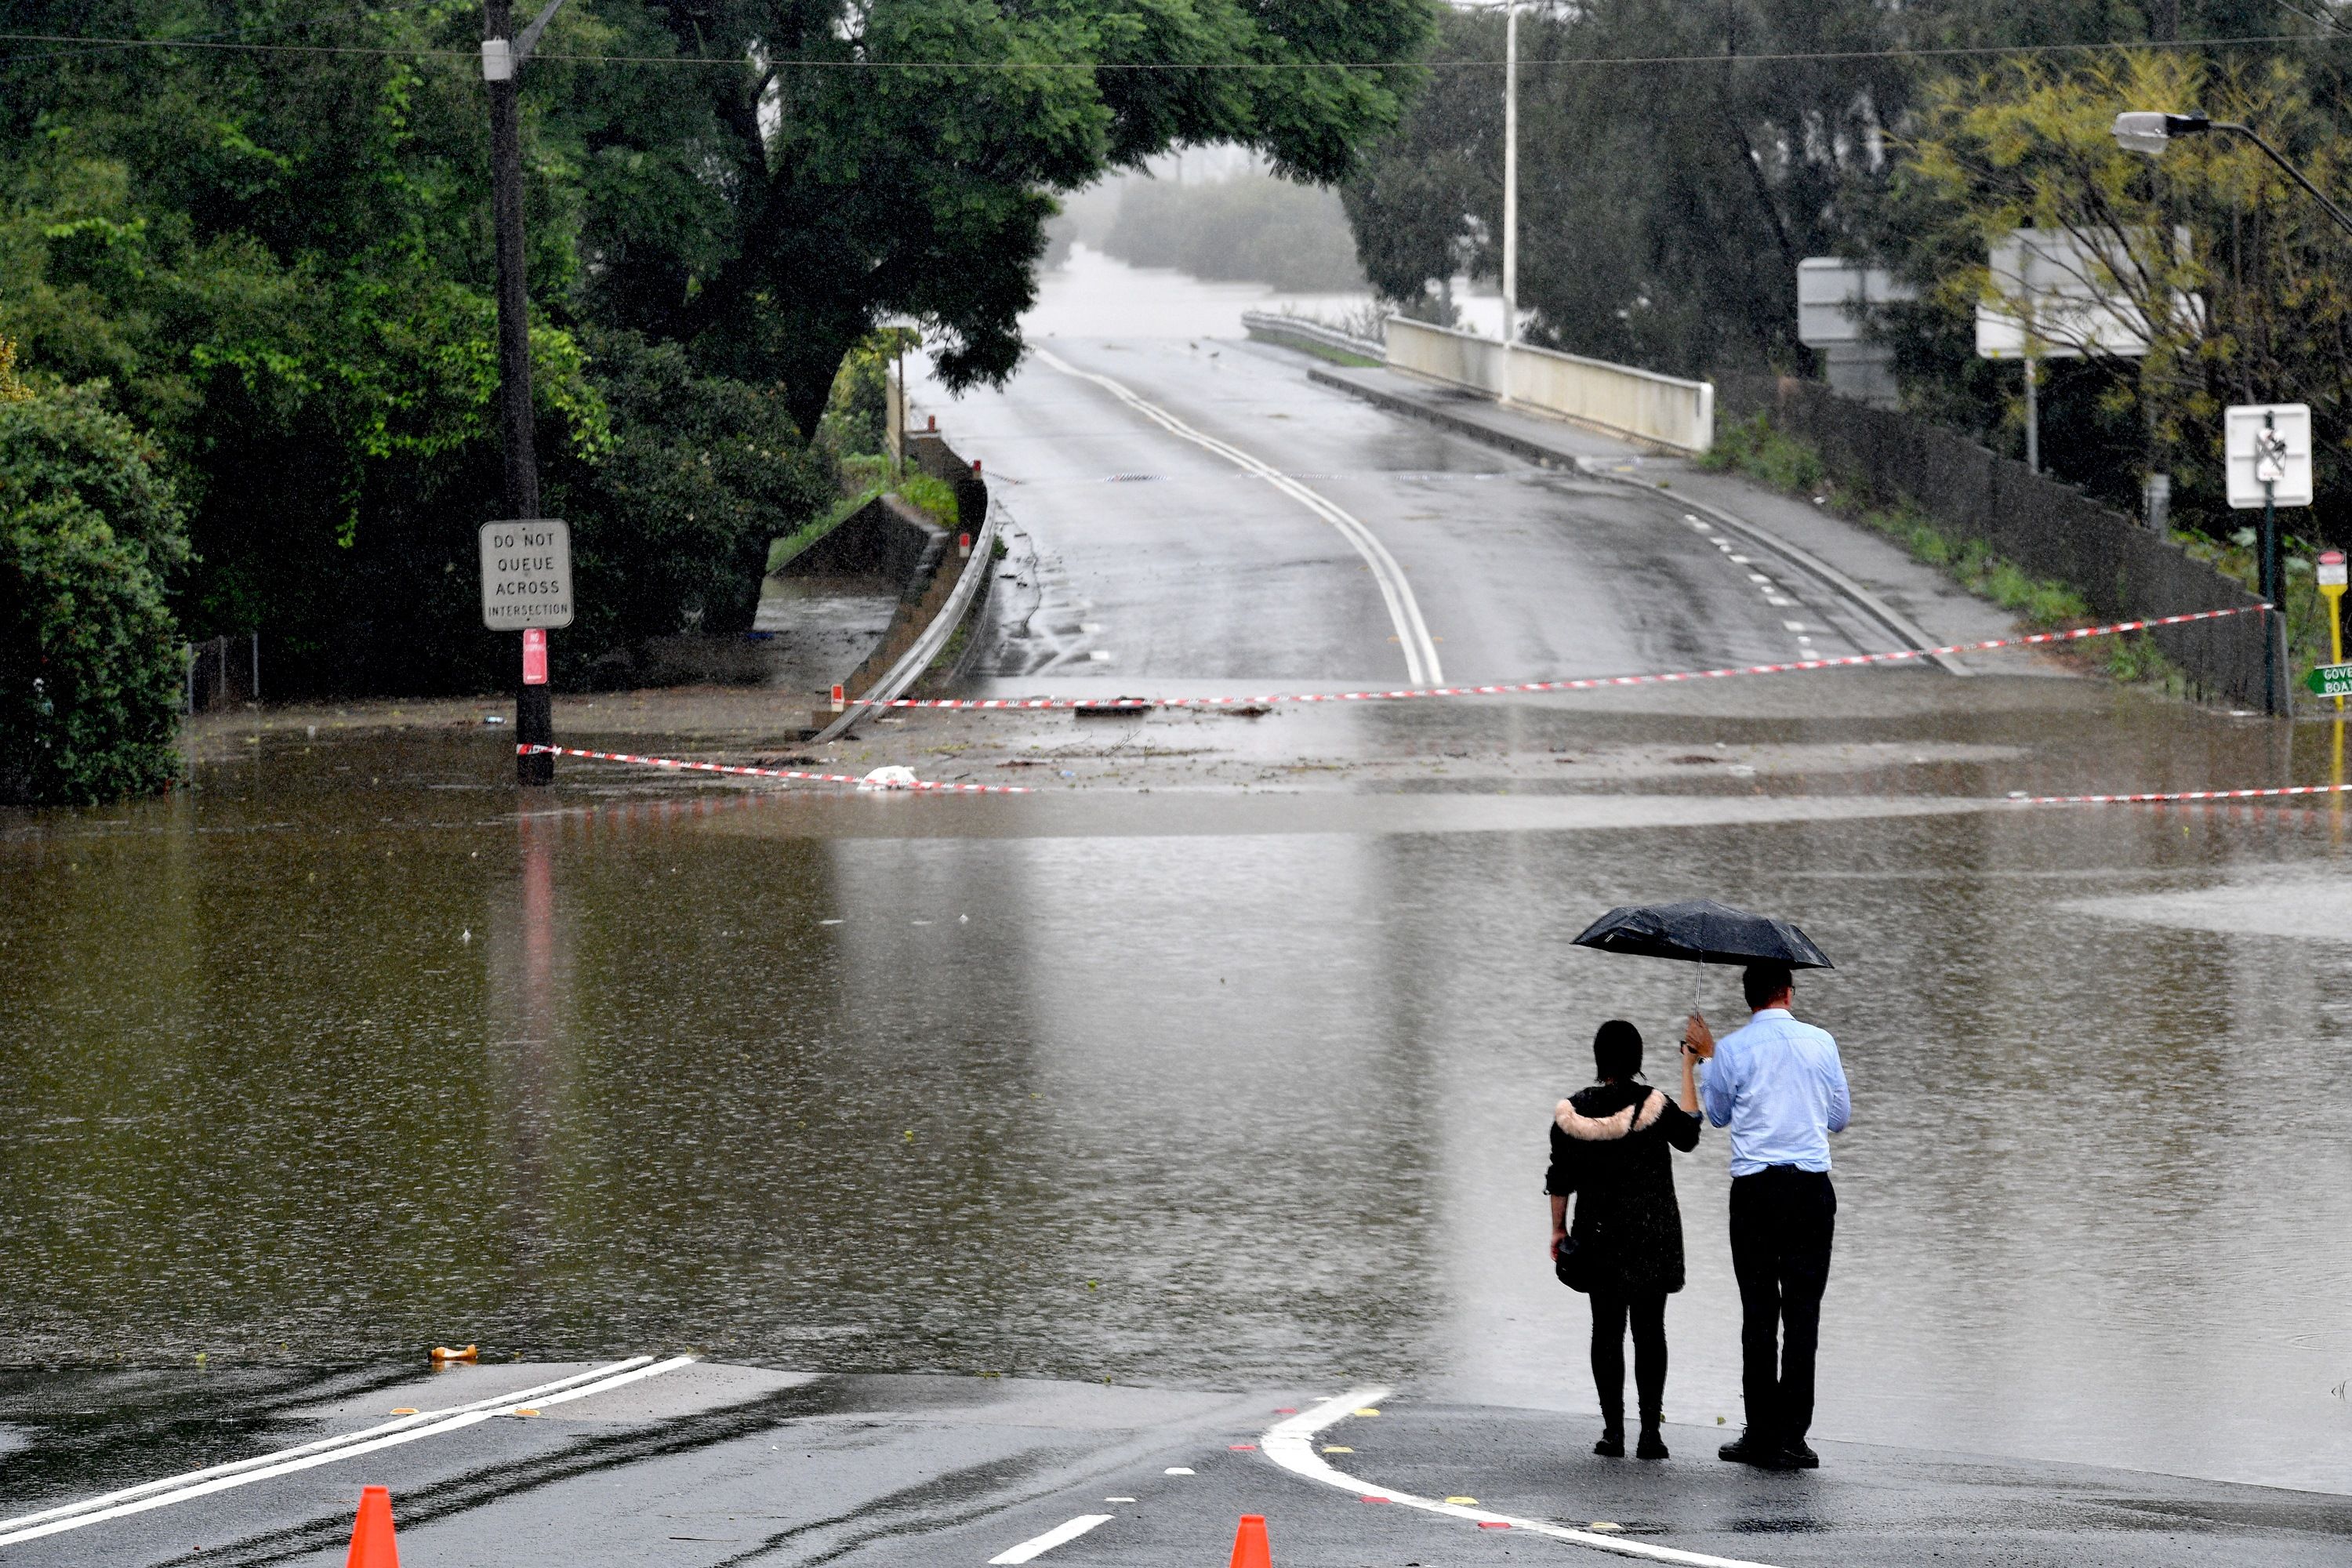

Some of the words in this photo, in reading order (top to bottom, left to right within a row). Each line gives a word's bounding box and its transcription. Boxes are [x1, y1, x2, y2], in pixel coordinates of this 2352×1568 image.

[494, 535, 514, 548] DO
[524, 532, 554, 546] NOT
[498, 557, 554, 572] QUEUE
[495, 580, 559, 595] ACROSS
[488, 604, 568, 617] INTERSECTION
